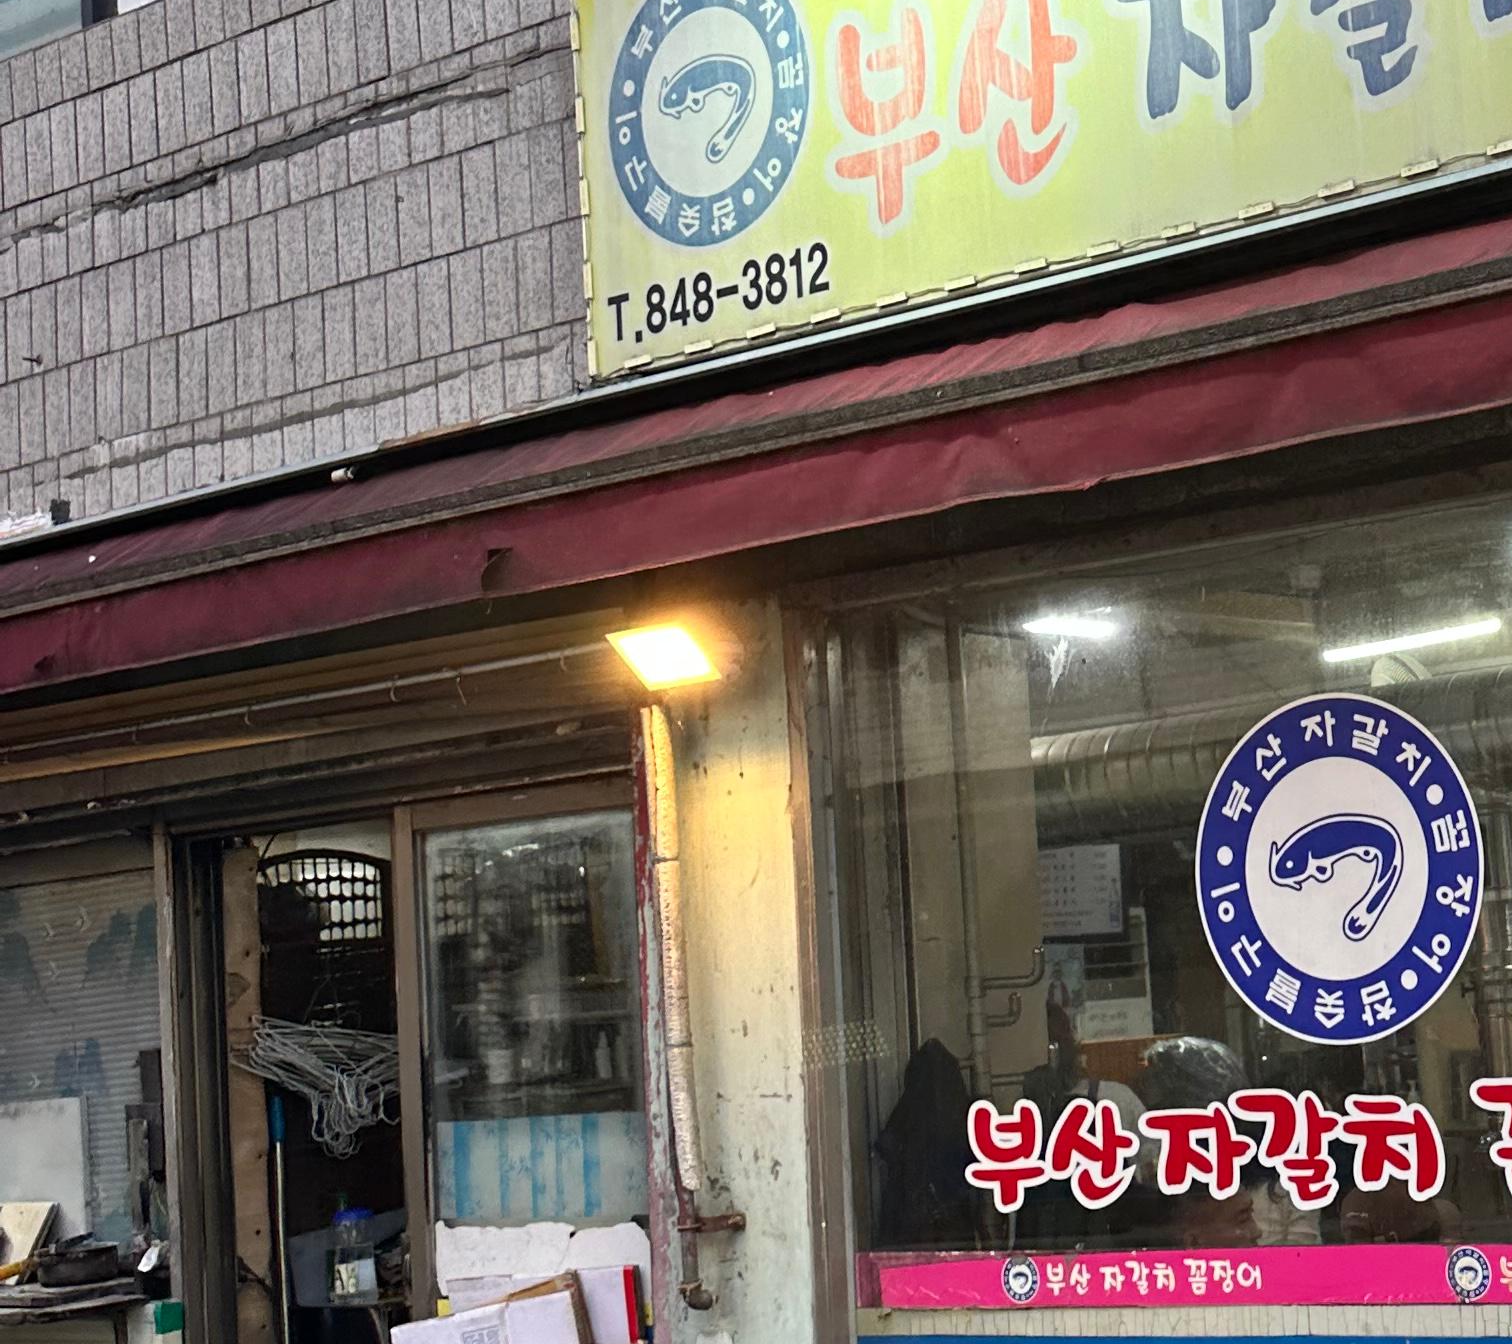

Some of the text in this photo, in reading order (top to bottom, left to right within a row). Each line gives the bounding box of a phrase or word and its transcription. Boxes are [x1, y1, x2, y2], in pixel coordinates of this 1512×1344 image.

[608, 244, 831, 346] T.848-3812
[968, 1098, 1139, 1212] 부산
[1139, 1087, 1446, 1210] 자갈치
[1046, 1262, 1091, 1296] 부산
[1099, 1260, 1176, 1296] 자갈치
[1184, 1258, 1263, 1296] 꼼장어
